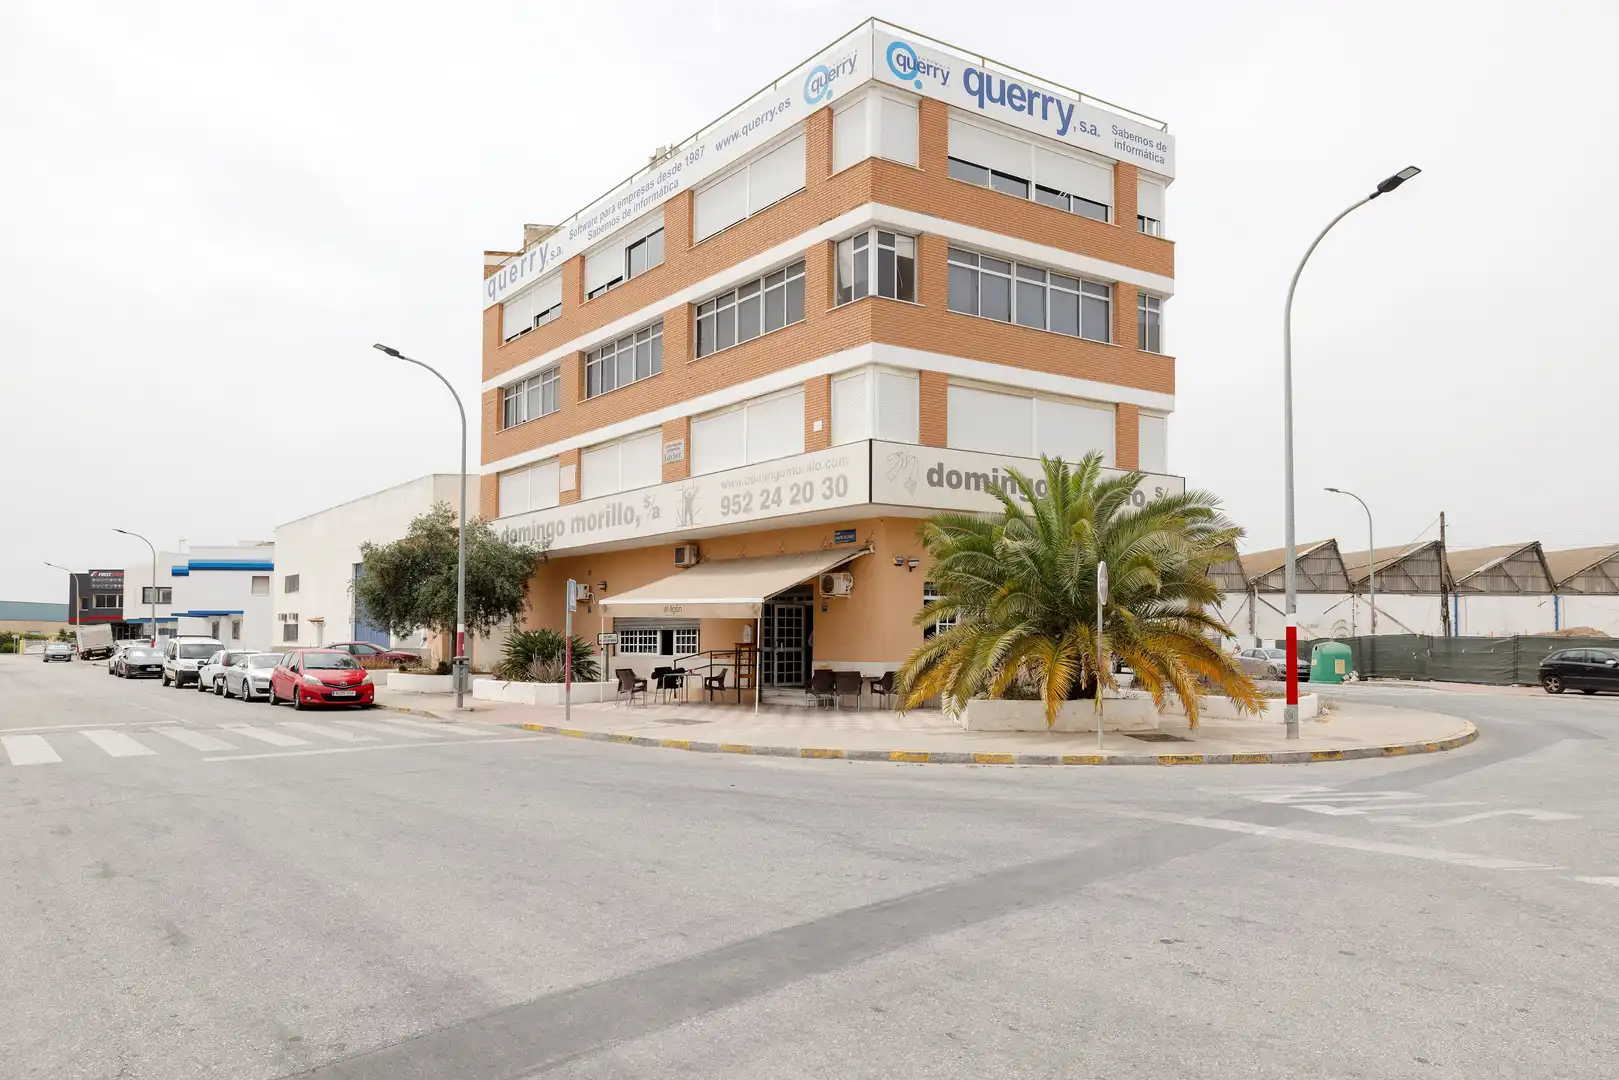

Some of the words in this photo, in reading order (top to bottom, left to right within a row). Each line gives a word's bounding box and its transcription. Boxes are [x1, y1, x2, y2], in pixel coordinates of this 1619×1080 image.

[811, 54, 857, 94] querry
[896, 53, 950, 86] querry
[715, 97, 791, 151] www.querry.es
[1111, 125, 1154, 148] Sabemos
[1156, 142, 1167, 152] de
[1114, 139, 1165, 164] informática
[569, 216, 598, 240] Software
[599, 205, 616, 223] para
[617, 179, 655, 209] empresas
[657, 162, 682, 184] desde
[685, 145, 705, 166] 1987
[588, 216, 620, 240] Sabemos
[622, 207, 632, 220] de
[633, 180, 679, 213] informática
[721, 491, 753, 516] 952
[760, 486, 782, 510] 24
[790, 481, 815, 505] 20
[822, 474, 848, 500] 30
[500, 518, 565, 544] domingo
